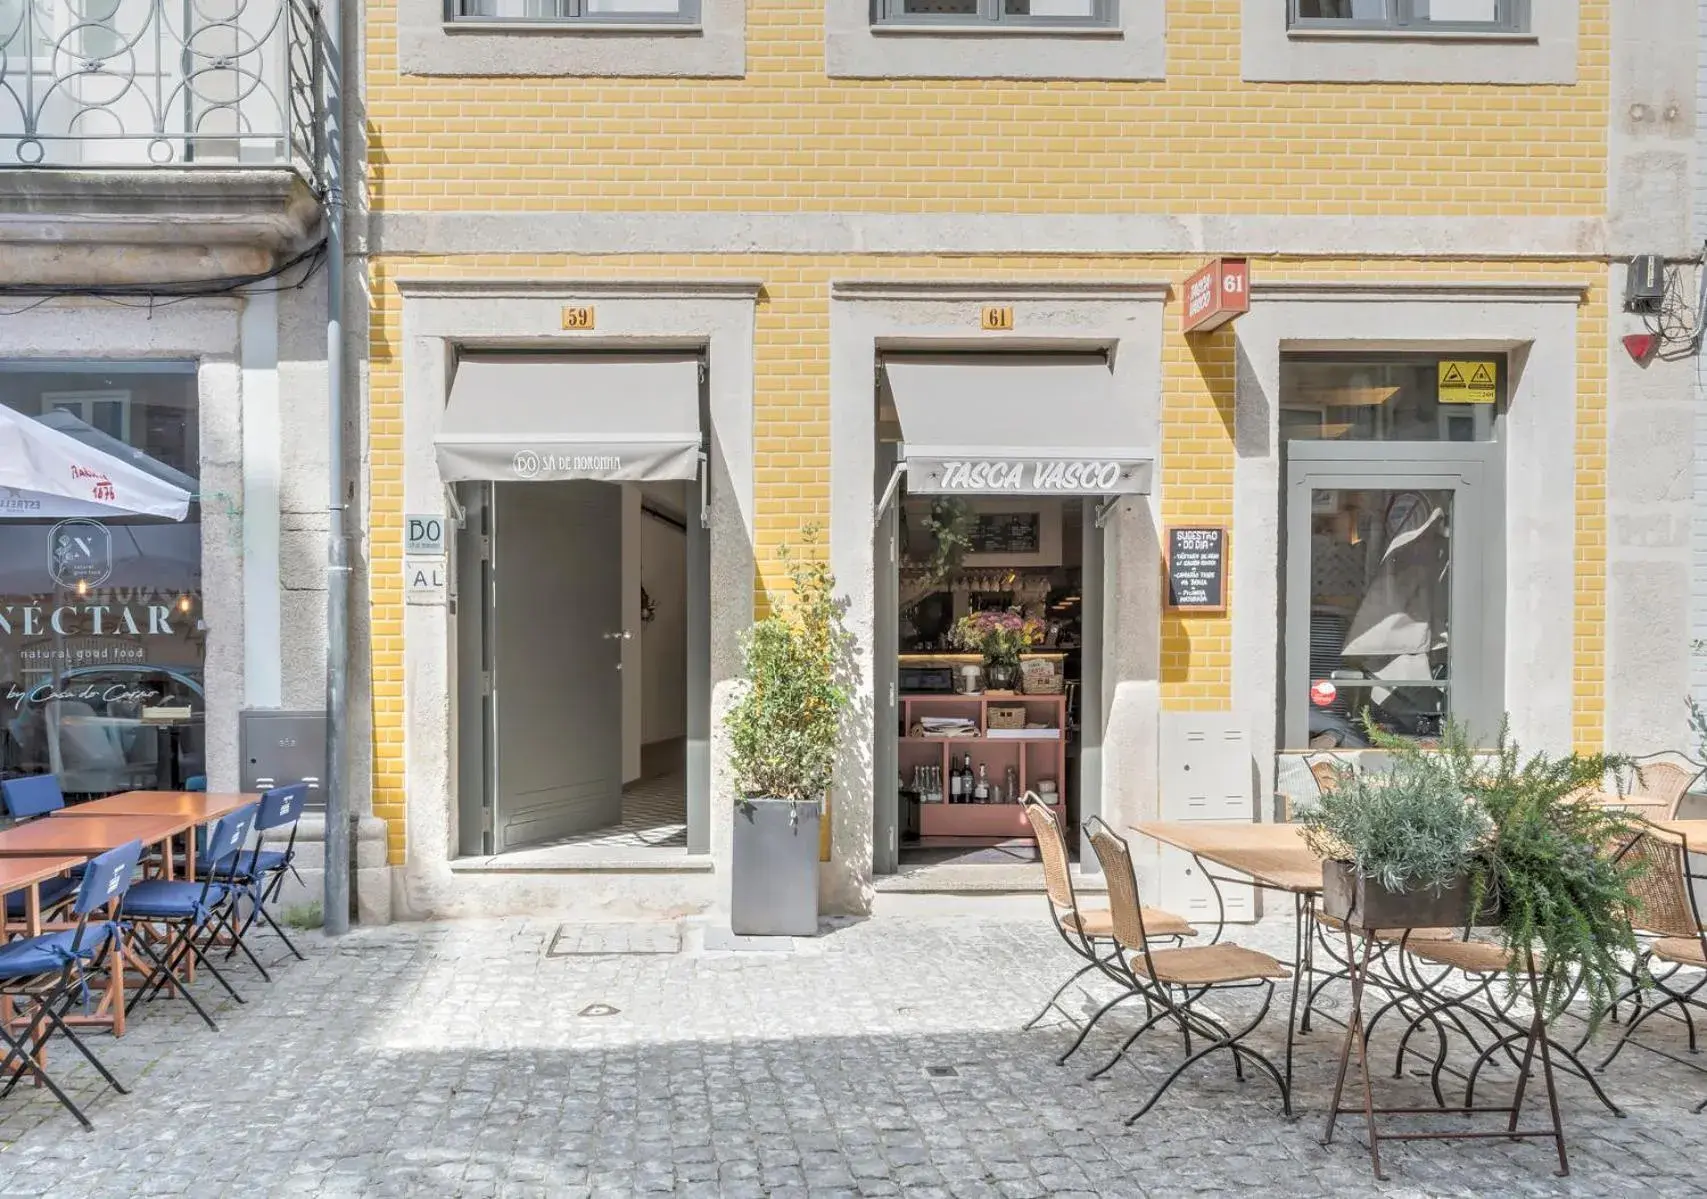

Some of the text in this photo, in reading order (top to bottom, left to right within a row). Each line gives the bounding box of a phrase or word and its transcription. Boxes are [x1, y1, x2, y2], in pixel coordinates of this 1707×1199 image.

[1224, 274, 1243, 293] 61
[568, 307, 588, 326] 59
[989, 308, 1006, 327] 61
[559, 456, 571, 470] DE
[941, 462, 1121, 489] TASCA VASCO
[409, 520, 441, 541] BO
[1183, 540, 1209, 549] DO DIA
[413, 570, 443, 587] AL
[0, 600, 174, 635] NÉCTAR
[20, 648, 144, 661] natural good food
[6, 684, 26, 711] by
